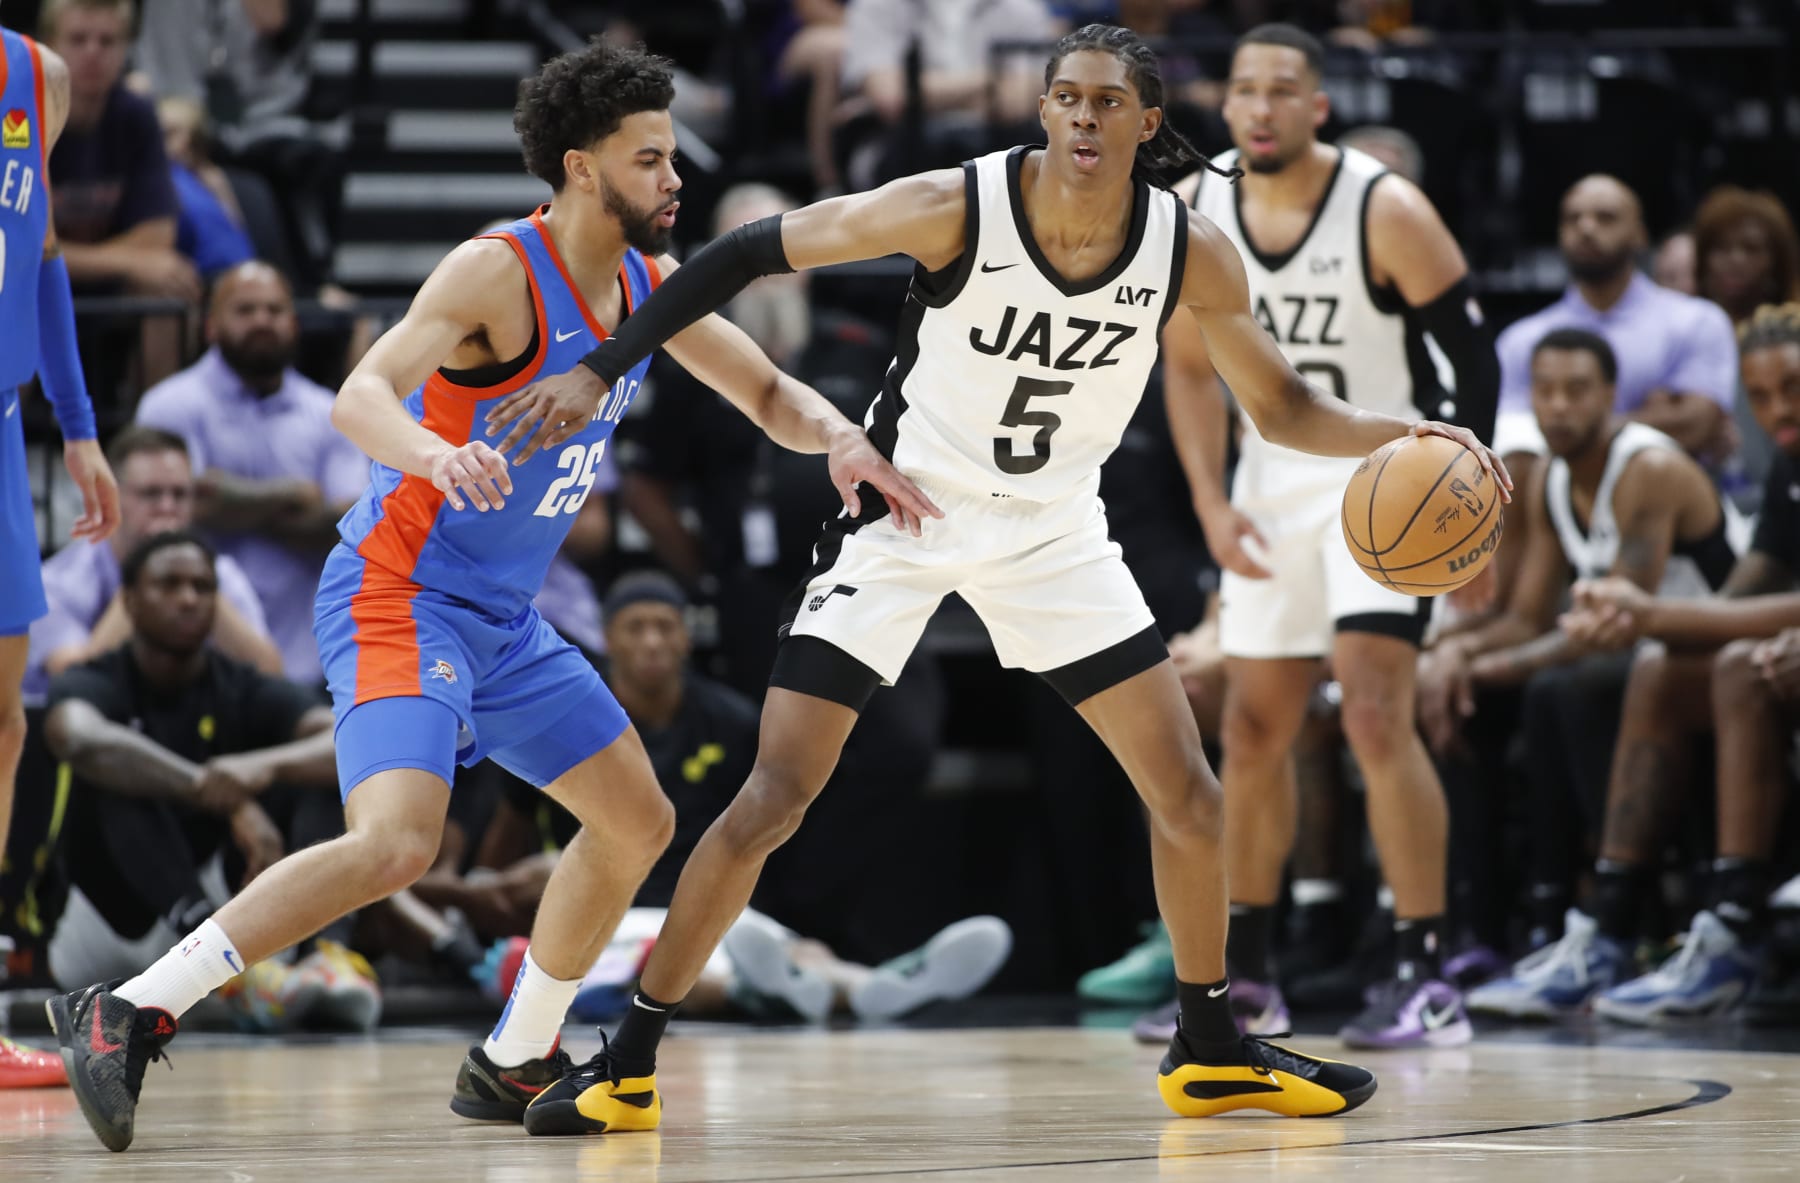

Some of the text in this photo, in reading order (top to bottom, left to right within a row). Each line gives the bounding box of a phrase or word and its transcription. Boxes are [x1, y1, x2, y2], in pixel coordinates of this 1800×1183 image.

[1114, 285, 1158, 307] LVT
[1253, 295, 1345, 345] AZZ
[969, 305, 1138, 371] JAZZ
[993, 375, 1075, 475] 5
[533, 438, 607, 518] 25
